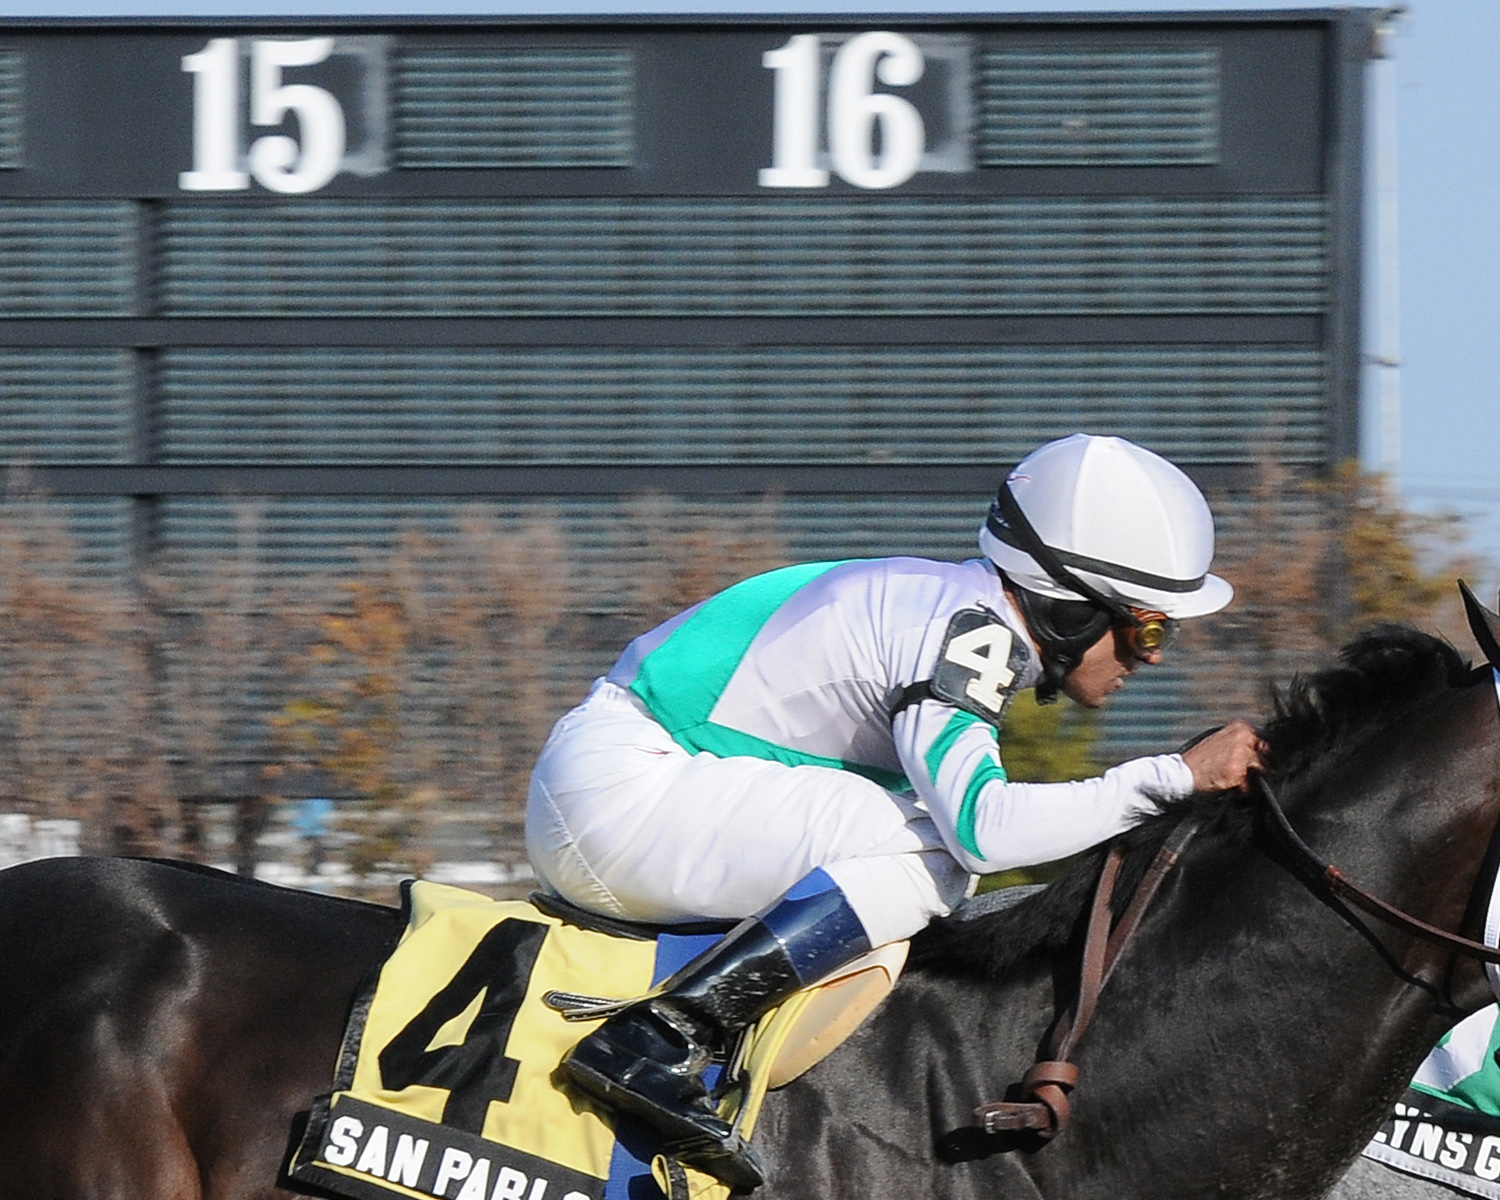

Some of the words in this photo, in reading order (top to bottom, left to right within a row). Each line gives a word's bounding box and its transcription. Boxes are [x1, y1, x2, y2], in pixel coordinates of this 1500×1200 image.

[178, 36, 348, 195] 15
[757, 30, 926, 190] 16
[944, 623, 1016, 713] 4
[377, 916, 551, 1138] 4
[323, 1115, 431, 1188] SAN
[1373, 1102, 1473, 1170] YNS
